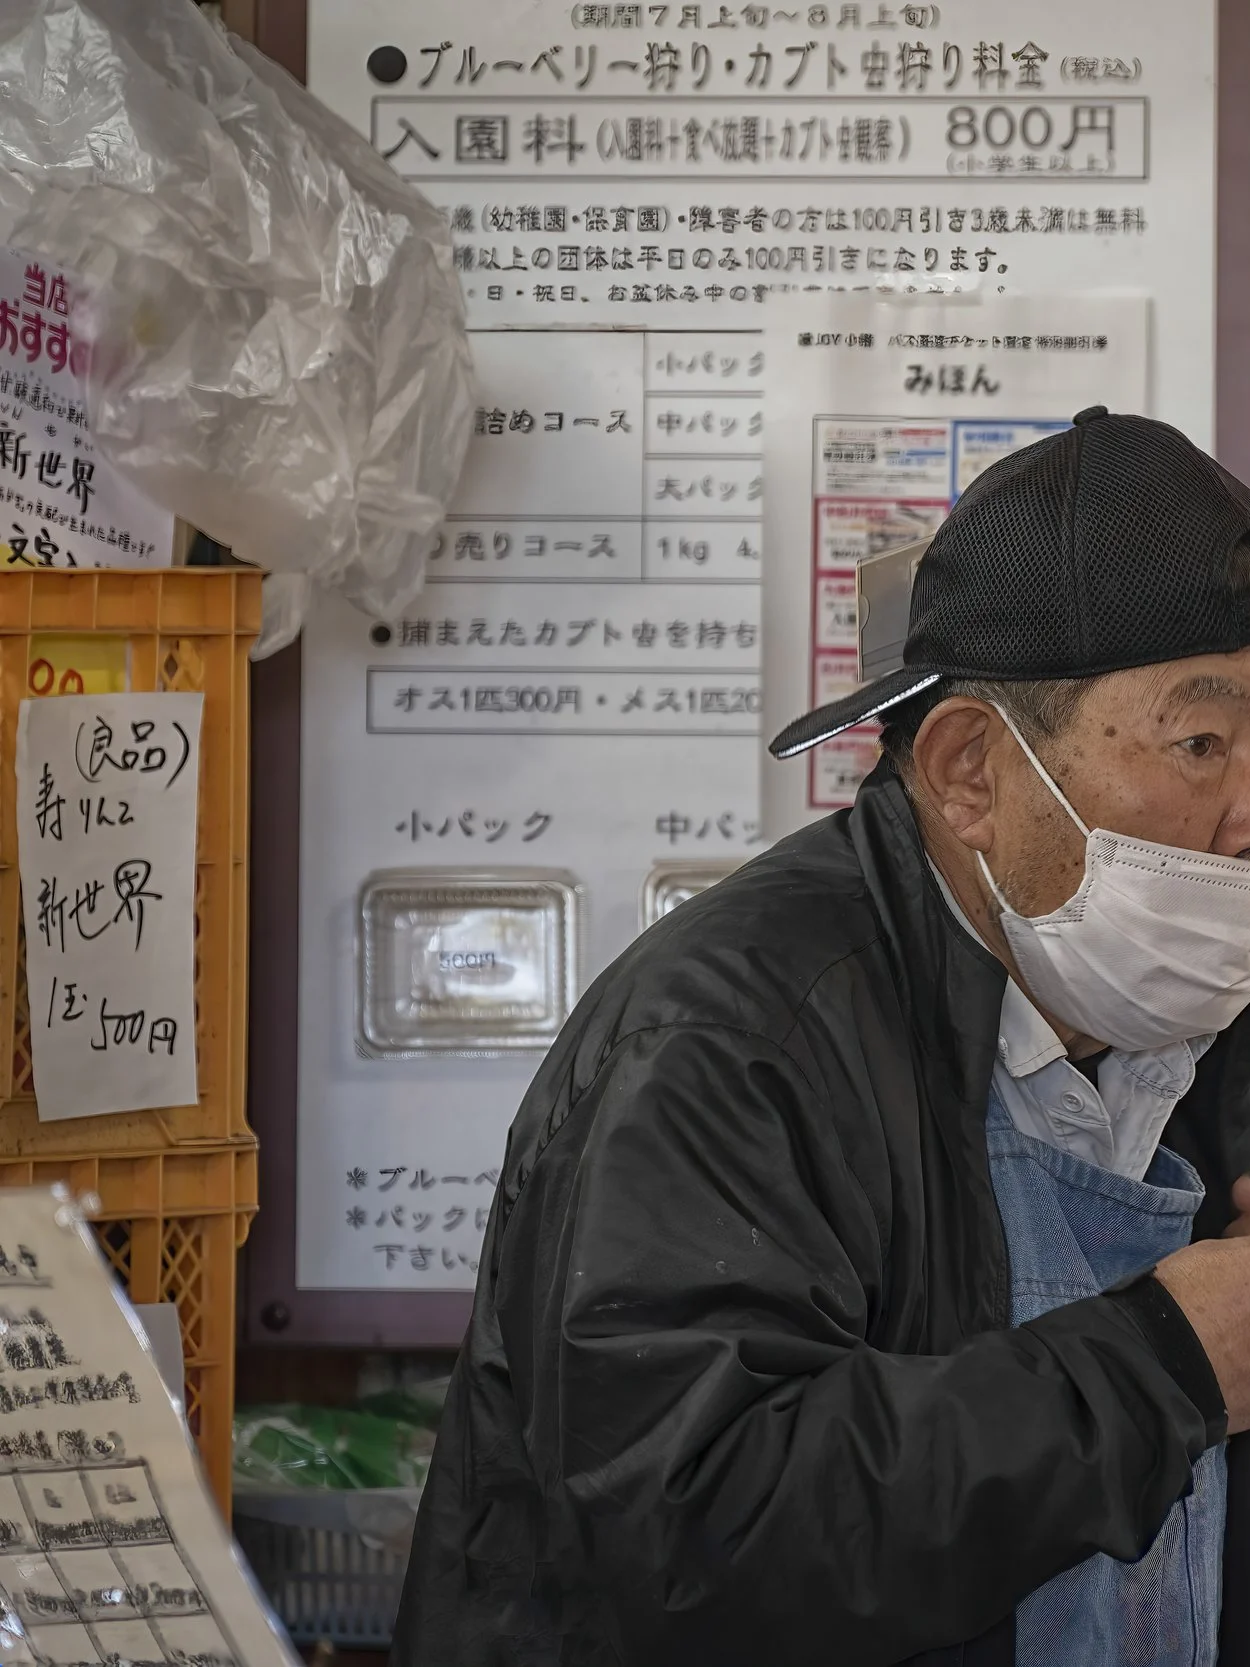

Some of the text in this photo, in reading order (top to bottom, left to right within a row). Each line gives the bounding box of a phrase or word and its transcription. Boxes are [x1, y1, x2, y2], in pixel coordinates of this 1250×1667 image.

[384, 113, 585, 164] 入園料
[945, 105, 1116, 153] 800円
[0, 298, 80, 378] おすす
[902, 363, 1002, 398] みほん
[395, 810, 553, 843] 小パック
[37, 859, 162, 953] 新世界
[90, 998, 177, 1056] 500円
